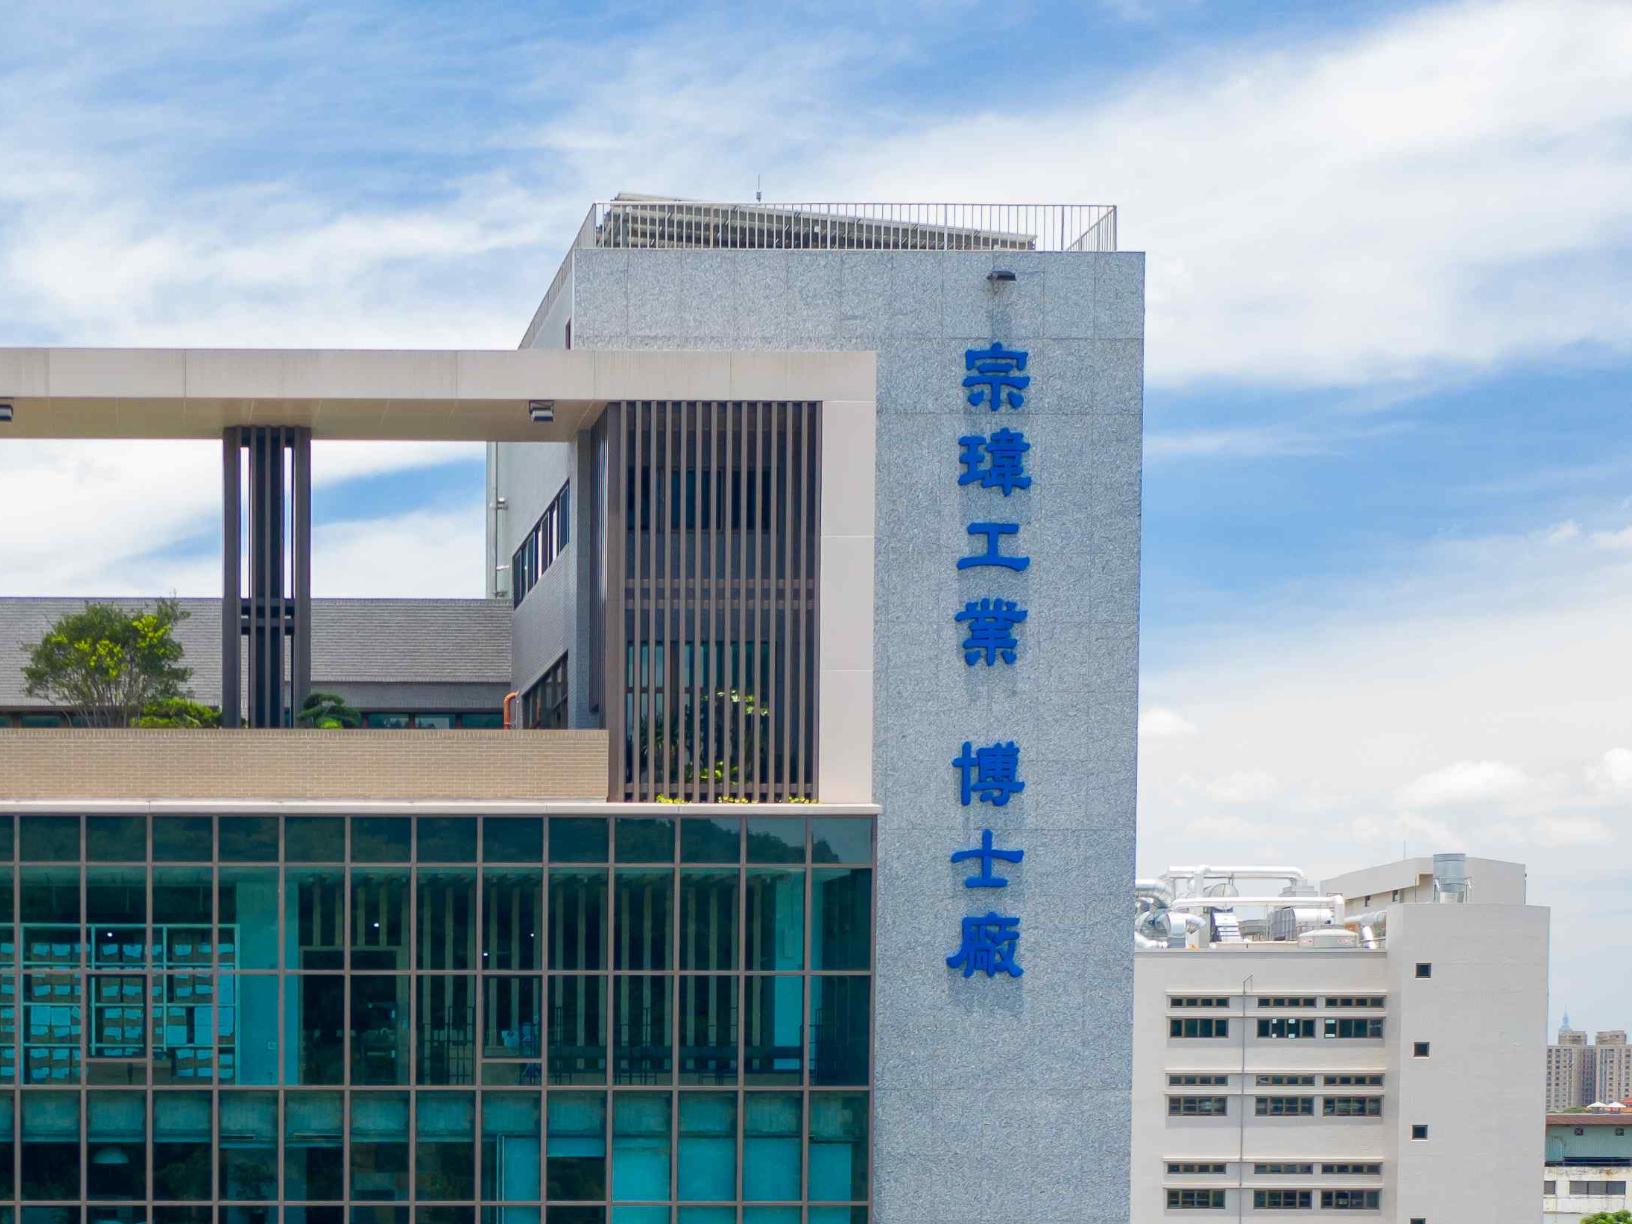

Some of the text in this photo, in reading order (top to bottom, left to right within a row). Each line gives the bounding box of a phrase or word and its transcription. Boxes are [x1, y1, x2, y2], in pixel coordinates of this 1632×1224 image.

[946, 342, 1032, 978] 宗瑋工業 博士廠
